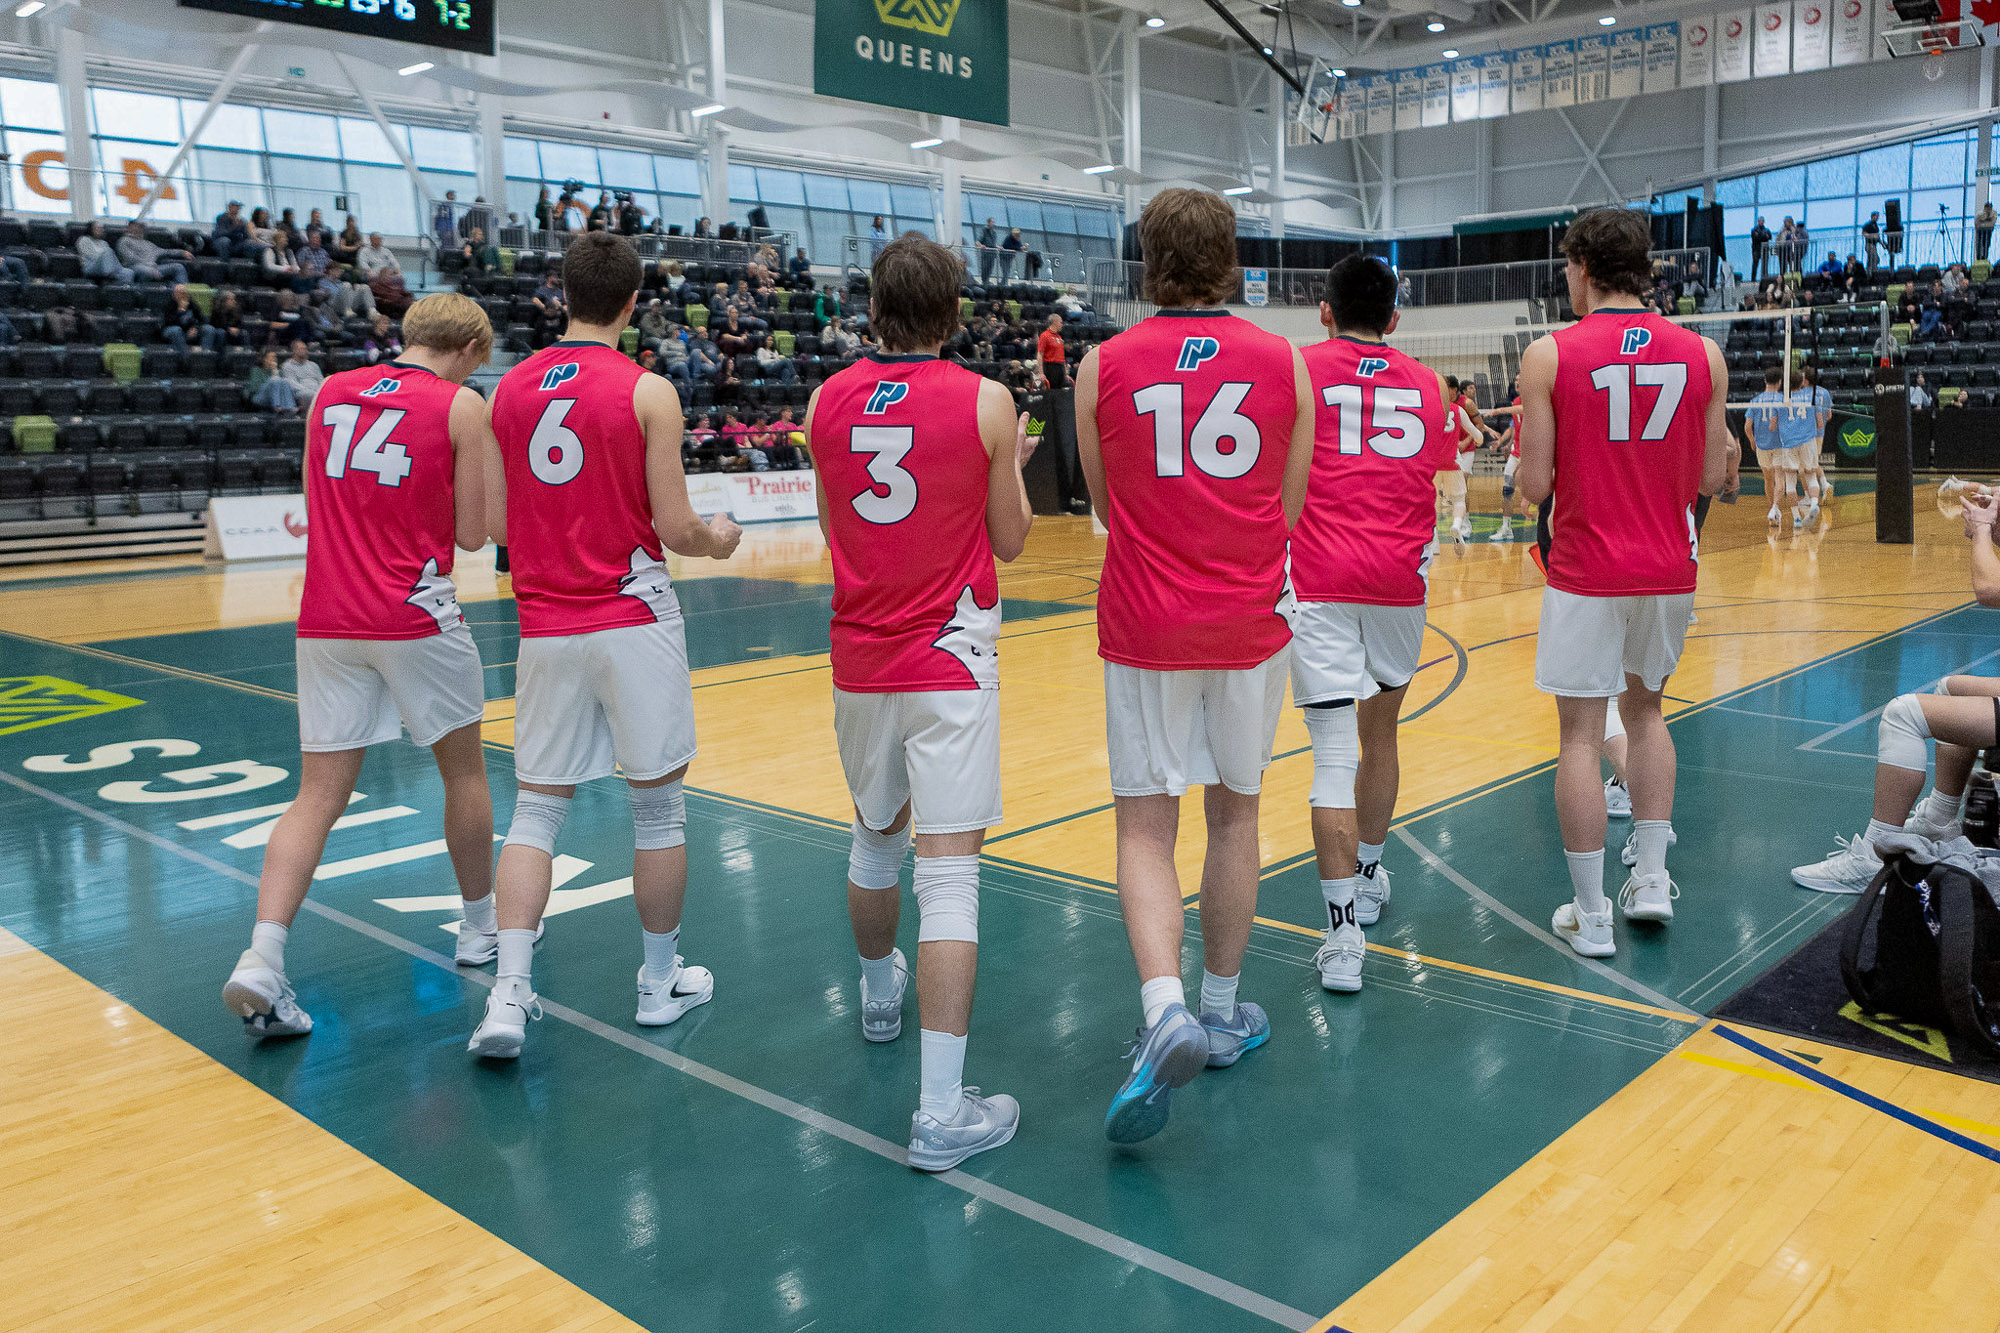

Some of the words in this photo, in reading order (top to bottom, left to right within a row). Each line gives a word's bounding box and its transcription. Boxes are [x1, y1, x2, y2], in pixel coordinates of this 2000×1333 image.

[855, 34, 974, 79] QUEENS
[528, 398, 585, 486] 6
[1132, 381, 1262, 479] 16
[1321, 383, 1426, 459] 15
[1589, 362, 1688, 442] 17
[323, 402, 413, 487] 14
[748, 476, 812, 495] Prairie
[850, 424, 919, 525] 3
